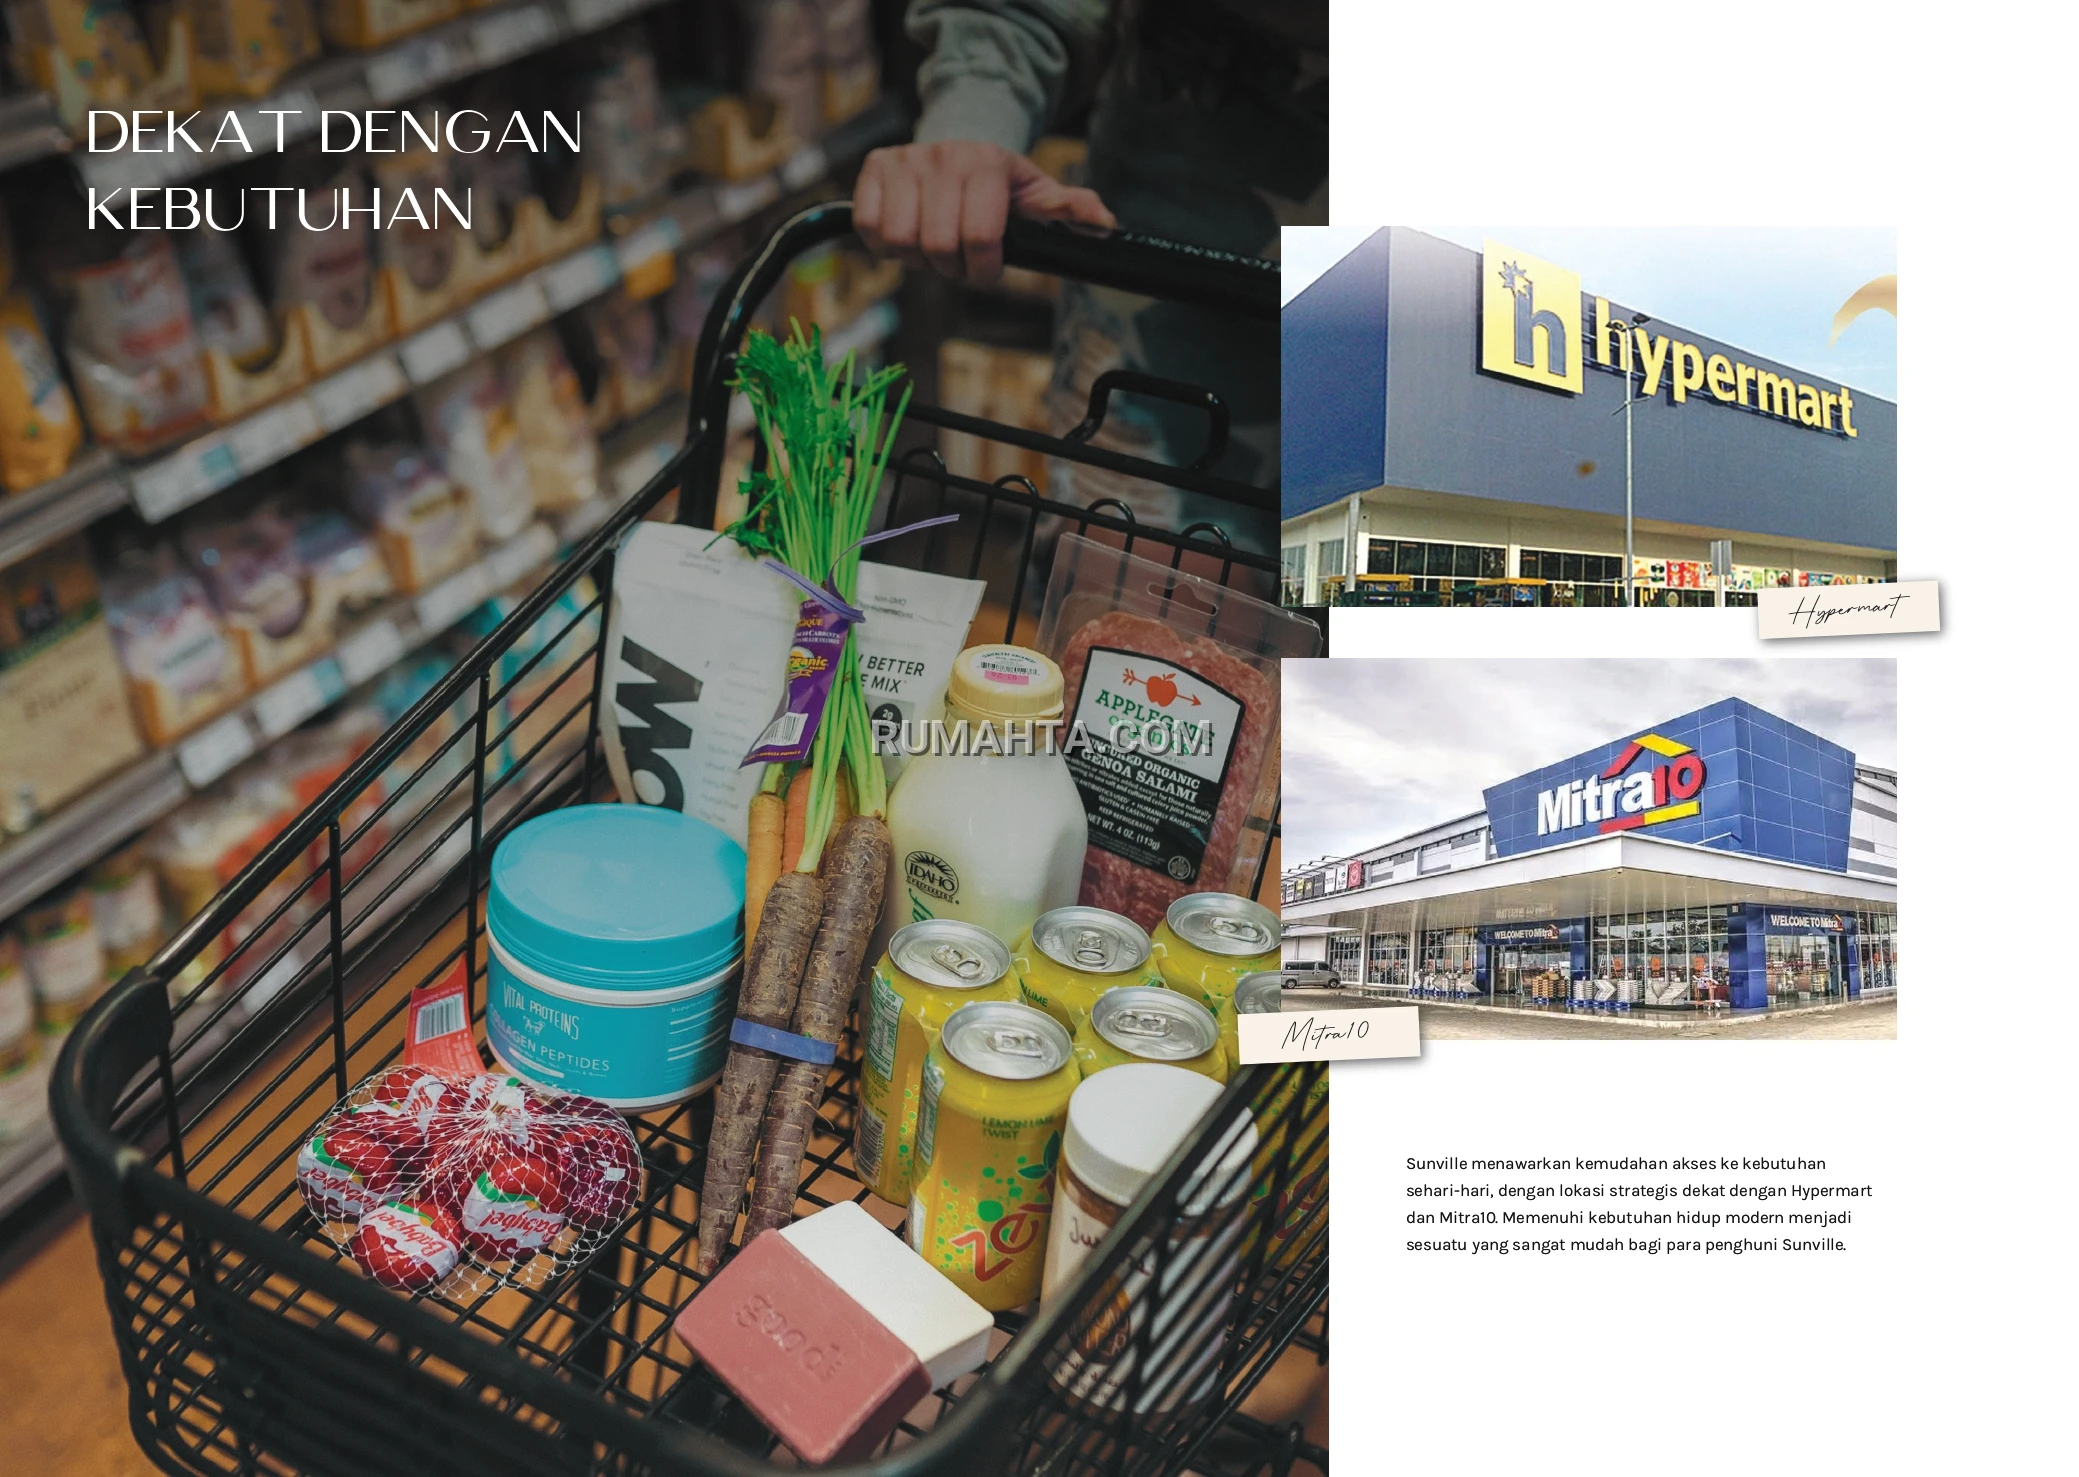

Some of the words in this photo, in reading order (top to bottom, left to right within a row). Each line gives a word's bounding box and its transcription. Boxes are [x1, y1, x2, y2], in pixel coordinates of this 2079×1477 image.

[1595, 297, 1858, 437] hypermart
[867, 656, 926, 678] BETTER
[871, 677, 903, 694] MIX
[1081, 747, 1133, 779] GENOA
[1135, 770, 1199, 804] SALAMI
[1143, 760, 1201, 790] ORGANIC
[1537, 754, 1706, 836] Mitra10
[1101, 817, 1116, 832] WT.
[1116, 826, 1123, 834] 4
[1123, 828, 1136, 840] OZ.
[1136, 833, 1161, 851] (113g)
[909, 862, 955, 892] IDAHO
[1494, 930, 1525, 940] WELCOME
[1525, 929, 1534, 938] TO
[1770, 914, 1810, 927] WELCOME
[1810, 917, 1821, 928] TO
[503, 981, 526, 1011] VITAL
[529, 999, 580, 1040] PROTEINS
[1027, 989, 1049, 1008] LIME
[490, 1003, 536, 1053] COLLAGEN
[540, 1045, 610, 1072] PEPTIDES
[982, 1116, 1028, 1130] LEMON
[1029, 1114, 1055, 1128] LIME
[982, 1128, 1020, 1140] TWIST
[369, 1209, 448, 1258] Babybel
[480, 1208, 564, 1243] Babybel
